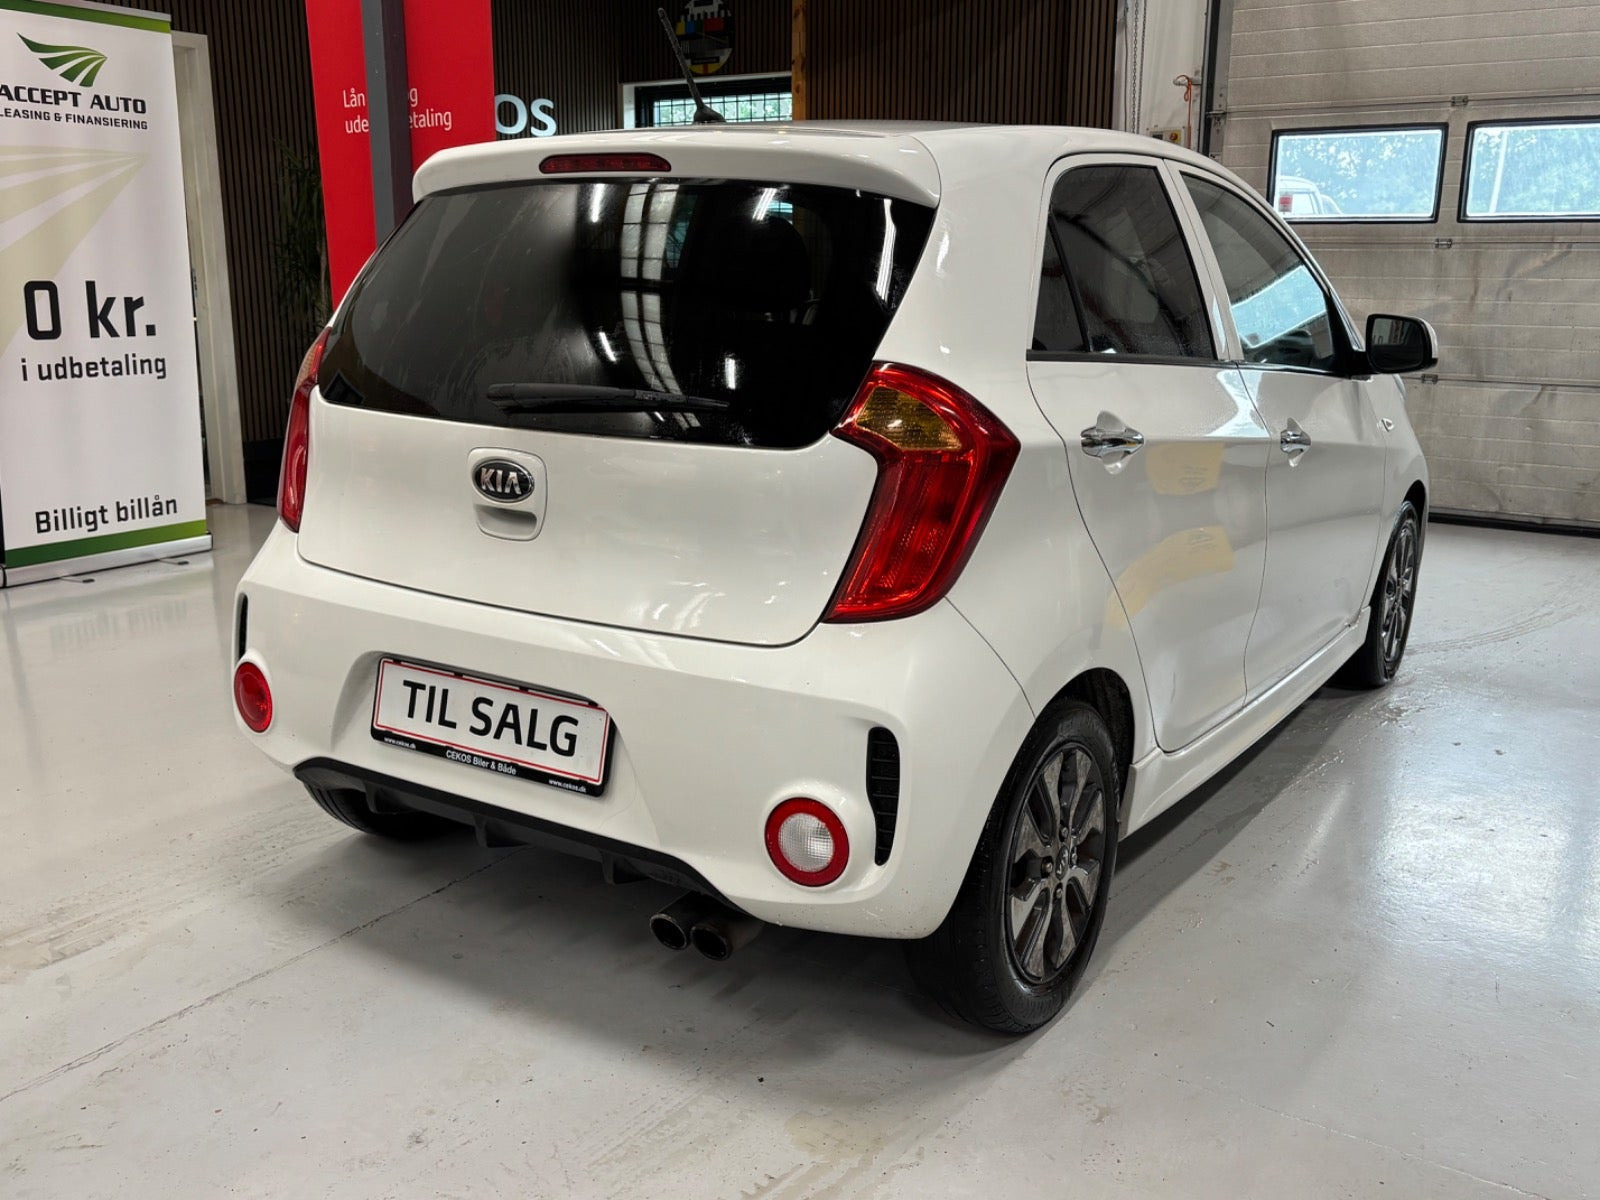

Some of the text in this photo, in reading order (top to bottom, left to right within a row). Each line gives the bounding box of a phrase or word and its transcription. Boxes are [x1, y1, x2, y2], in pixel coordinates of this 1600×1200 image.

[0, 84, 147, 114] ACCEPT AUTO
[343, 87, 418, 108] Lån g
[54, 112, 62, 122] &
[66, 113, 148, 130] FINANSIERING
[23, 280, 157, 340] 0 kr.
[21, 353, 167, 381] i udbetaling
[480, 467, 522, 494] KIA
[35, 494, 177, 534] Billigt billån
[403, 679, 579, 757] TIL SALG
[446, 749, 517, 776] CEKOS Biler & Både
[548, 778, 587, 794] www.cekos.dk
